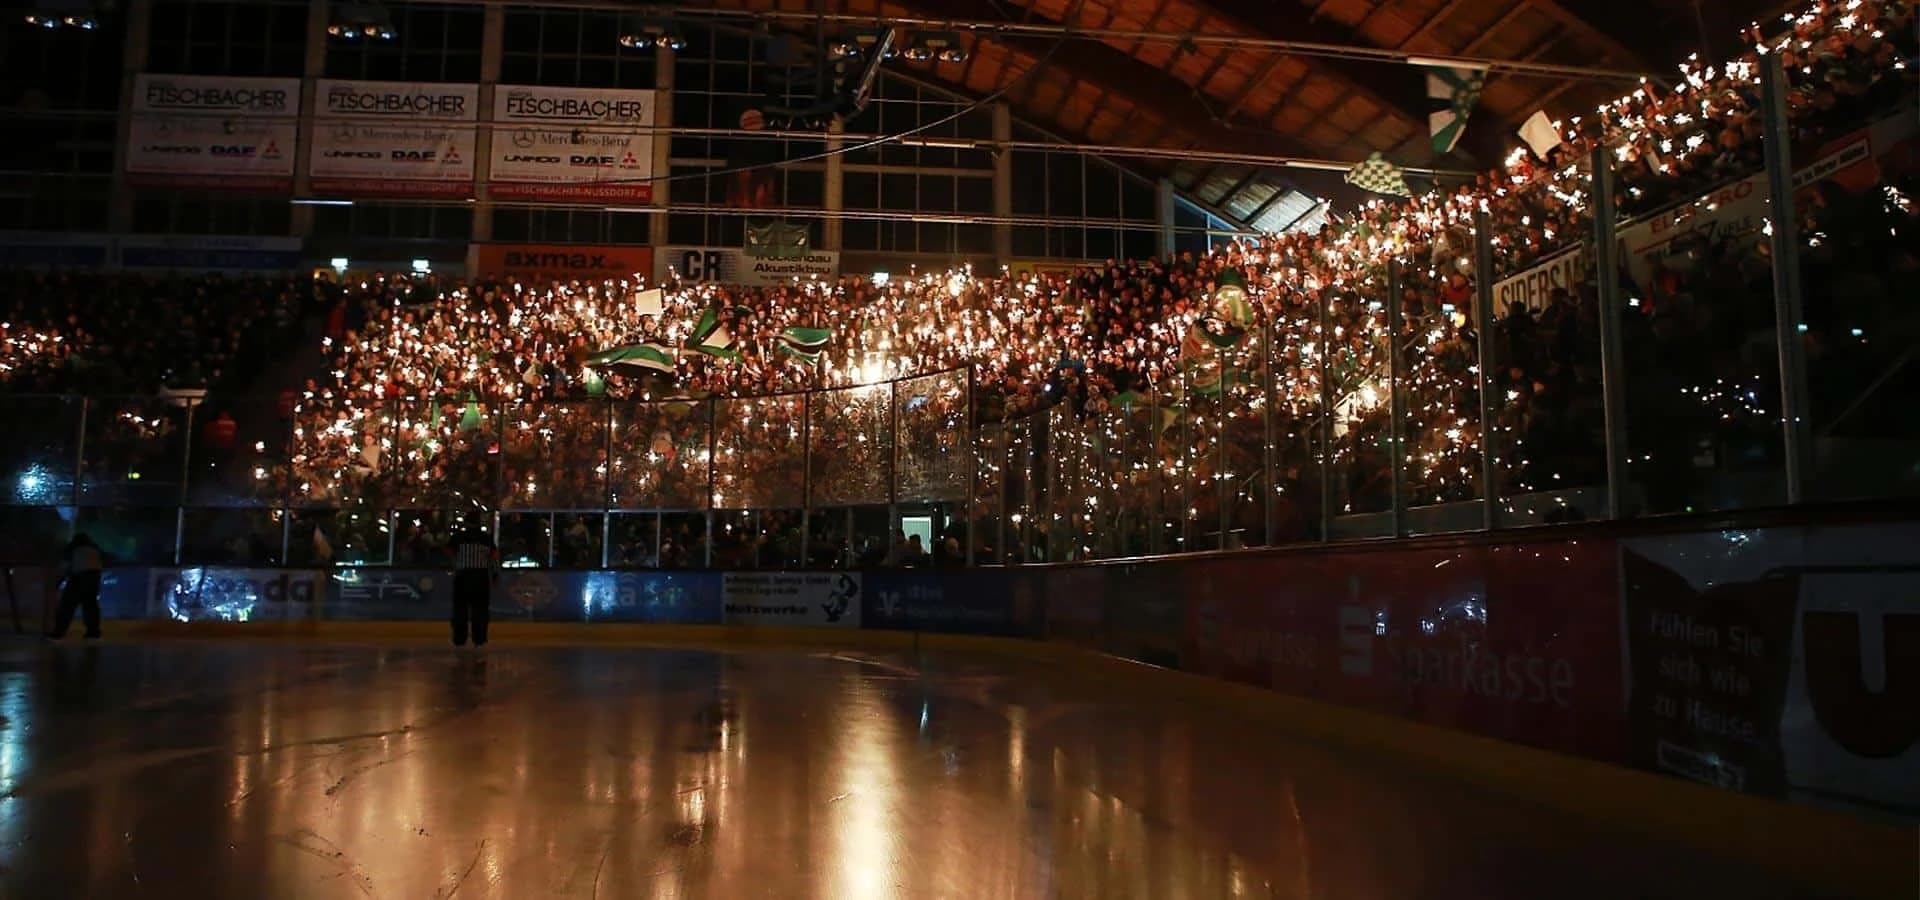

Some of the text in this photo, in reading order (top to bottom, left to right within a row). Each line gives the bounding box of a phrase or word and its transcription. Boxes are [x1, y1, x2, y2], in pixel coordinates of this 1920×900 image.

[147, 87, 286, 106] FISCHBACHER
[328, 93, 465, 112] FISCHBACHER
[507, 98, 641, 118] FISCHBACHER
[541, 132, 630, 149] Mercdes-Benz
[392, 151, 437, 161] DAF
[570, 156, 616, 165] DAF
[504, 251, 608, 270] axmax
[683, 250, 721, 281] CR
[753, 263, 832, 275] Akustikbau
